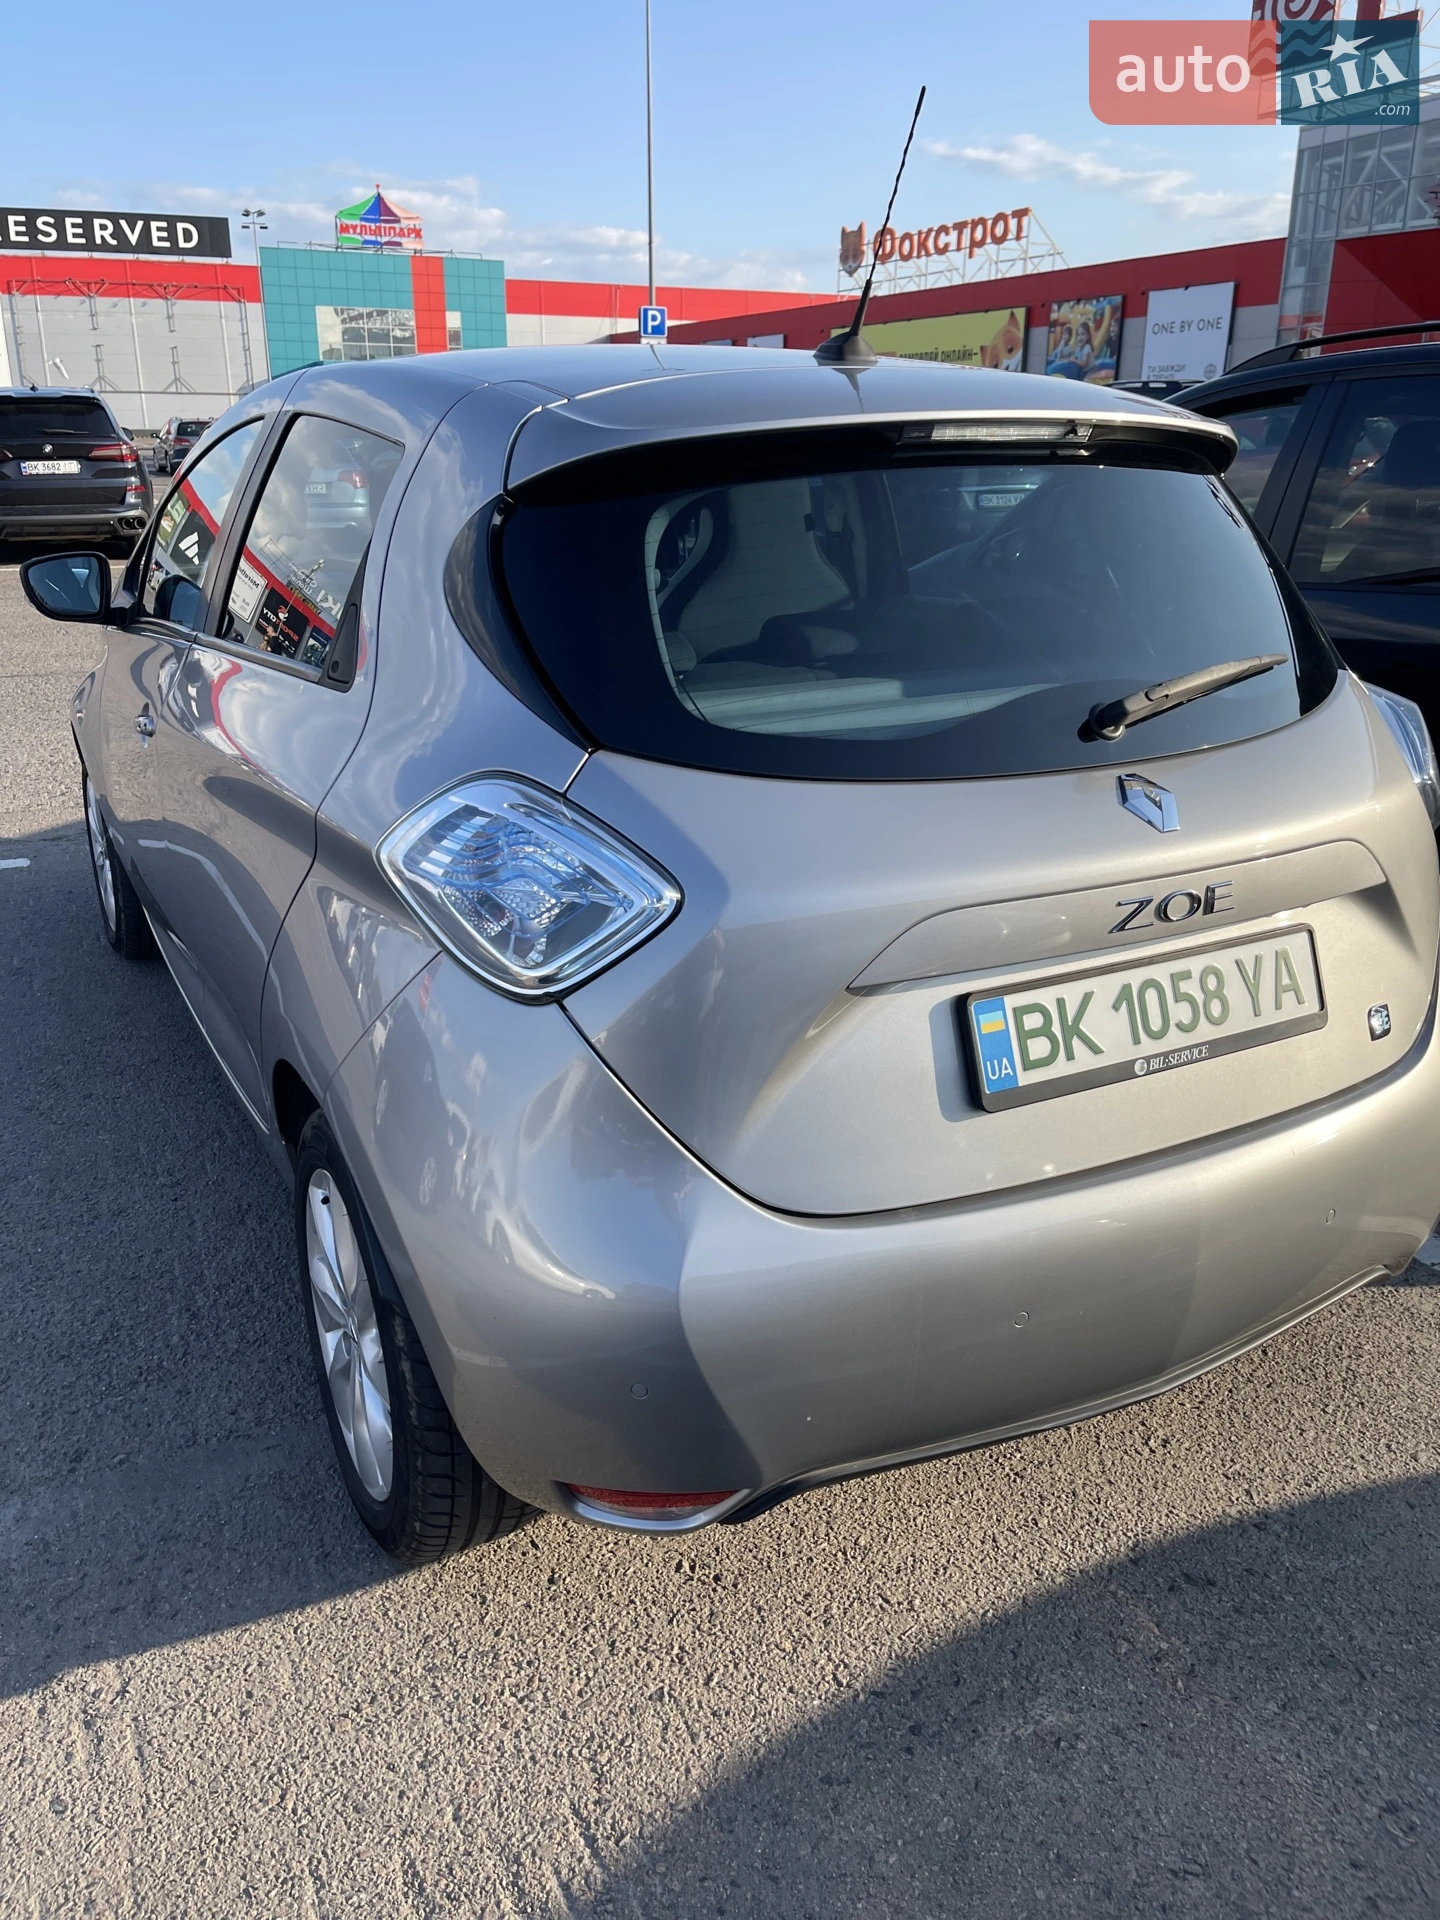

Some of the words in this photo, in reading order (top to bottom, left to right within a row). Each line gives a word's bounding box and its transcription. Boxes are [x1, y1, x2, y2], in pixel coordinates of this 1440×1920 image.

[0, 215, 199, 248] ESERVED
[648, 310, 661, 333] P
[1152, 321, 1176, 335] ONE
[1180, 320, 1193, 333] BY
[1197, 316, 1223, 331] ONE
[42, 463, 61, 471] 3682
[1107, 880, 1235, 934] ZOE
[1013, 989, 1105, 1072] BK
[1111, 964, 1230, 1046] 1058
[1235, 946, 1307, 1018] YA
[986, 1056, 1014, 1081] UA
